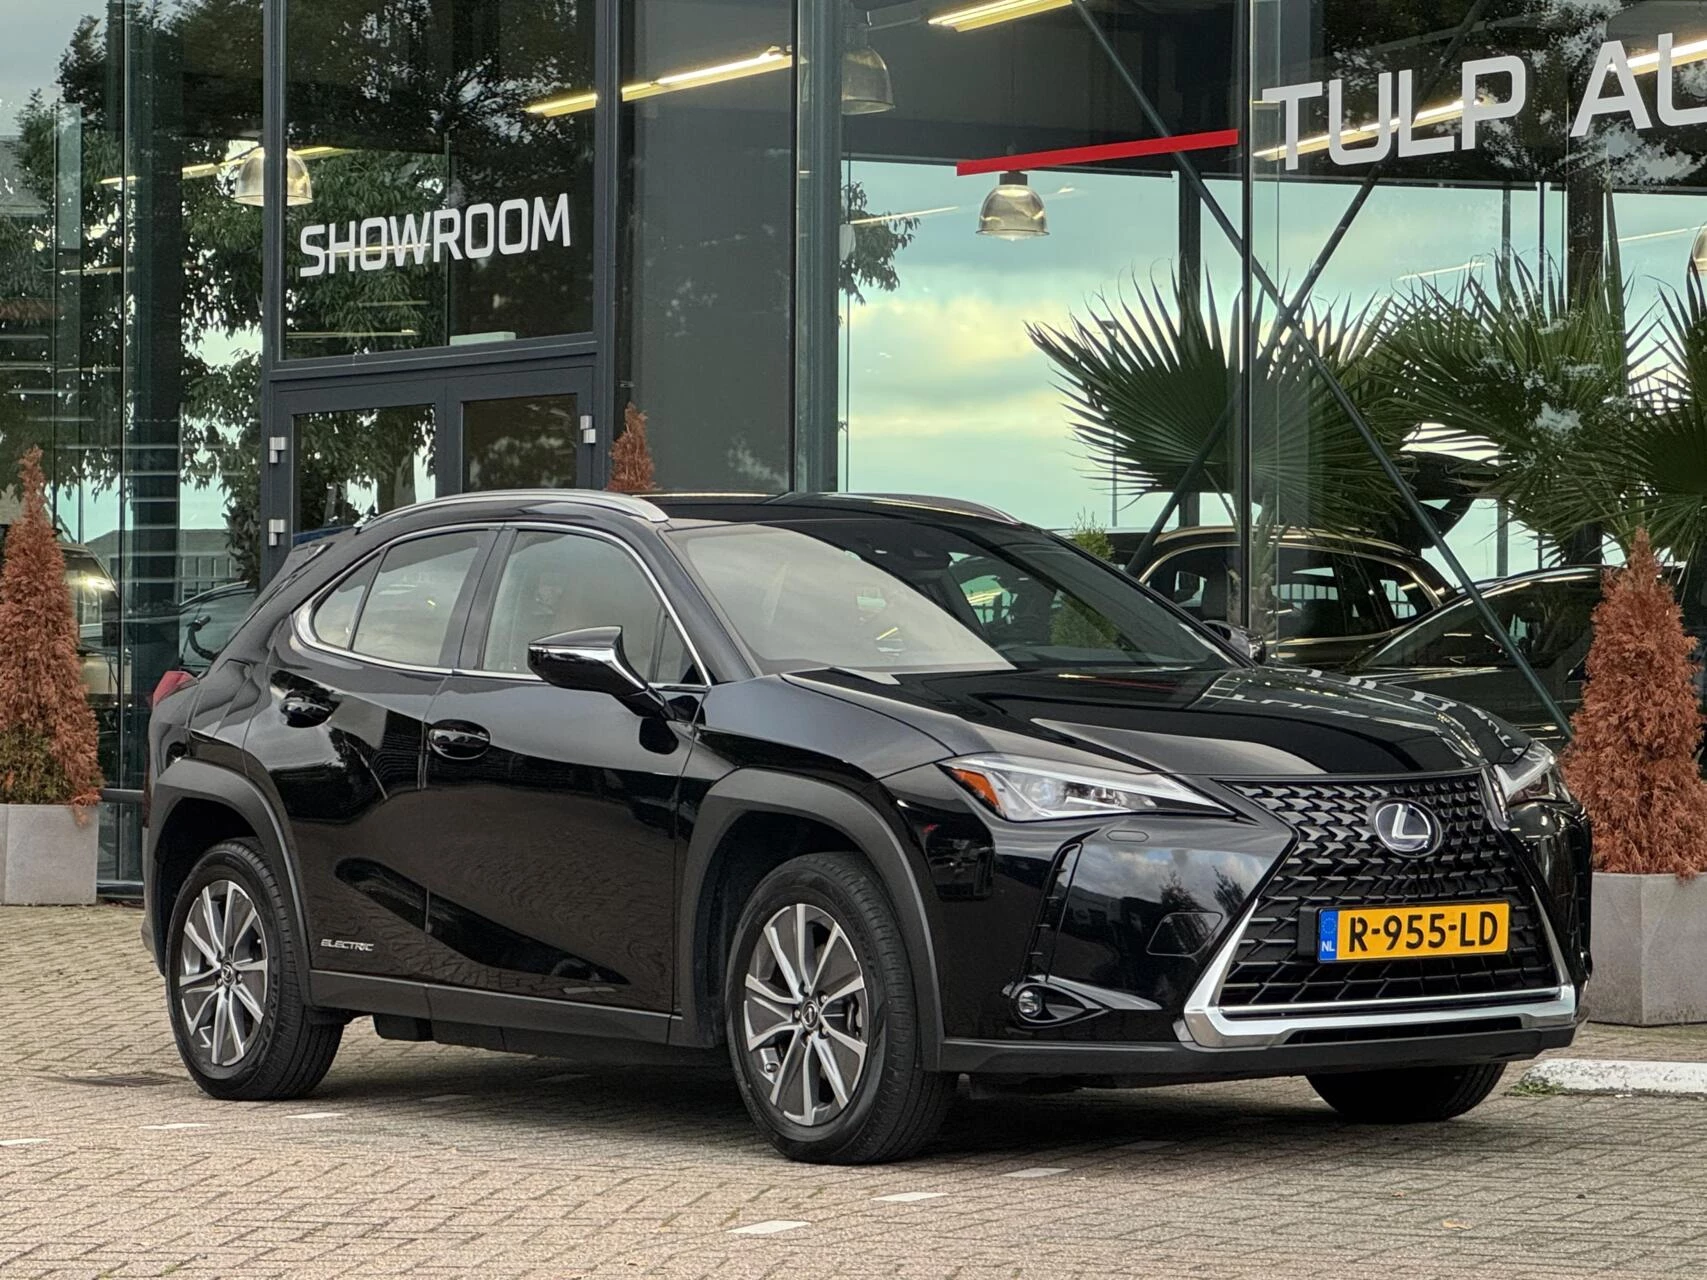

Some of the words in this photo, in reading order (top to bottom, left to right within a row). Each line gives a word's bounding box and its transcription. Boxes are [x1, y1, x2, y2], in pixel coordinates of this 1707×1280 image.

[1261, 55, 1526, 170] TULP
[299, 192, 572, 278] SHOWROOM
[320, 938, 375, 952] ELECTRIC
[1321, 941, 1335, 952] NL
[1348, 910, 1498, 953] R-955-LD
